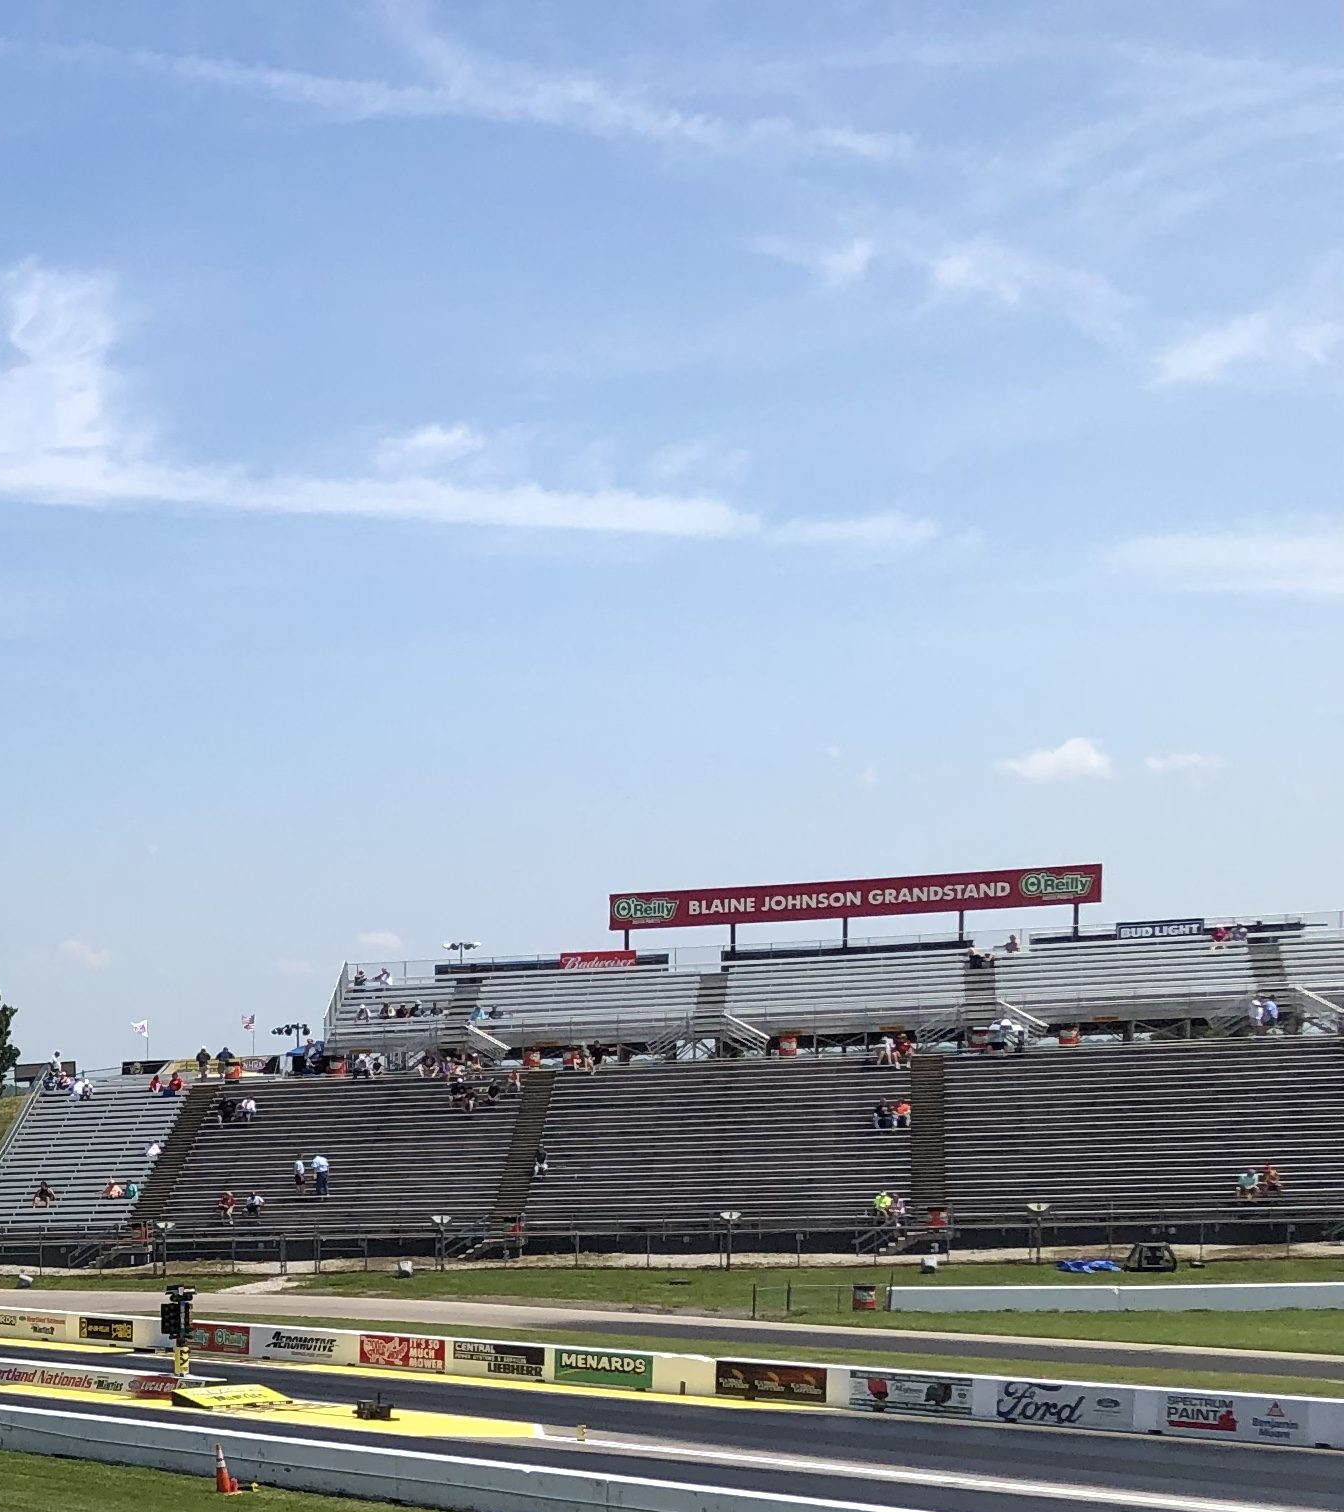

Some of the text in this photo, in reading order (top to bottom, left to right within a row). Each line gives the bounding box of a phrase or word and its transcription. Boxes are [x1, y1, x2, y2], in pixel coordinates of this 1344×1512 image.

[1020, 872, 1093, 897] O'Reilly
[688, 881, 1011, 916] BLAINE JOHNSON GRANDSTAND
[613, 896, 677, 919] O'Reilly
[1120, 923, 1200, 938] BUD LIGHT
[561, 955, 636, 970] Budweiser
[242, 1058, 266, 1071] NHRA
[265, 1330, 340, 1353] AEROMOTIVE
[409, 1337, 440, 1349] IT'S SO
[454, 1341, 496, 1354] CENTRAL
[408, 1347, 436, 1359] MUCH
[408, 1358, 443, 1370] MOWER
[487, 1362, 543, 1378] LIEBHERR
[561, 1352, 646, 1373] MENARDS
[38, 1369, 93, 1389] Nationals
[140, 1381, 163, 1393] LUCAS
[996, 1380, 1086, 1423] Ford
[1166, 1394, 1235, 1410] SPECTRUM
[1166, 1406, 1220, 1422] PAINT
